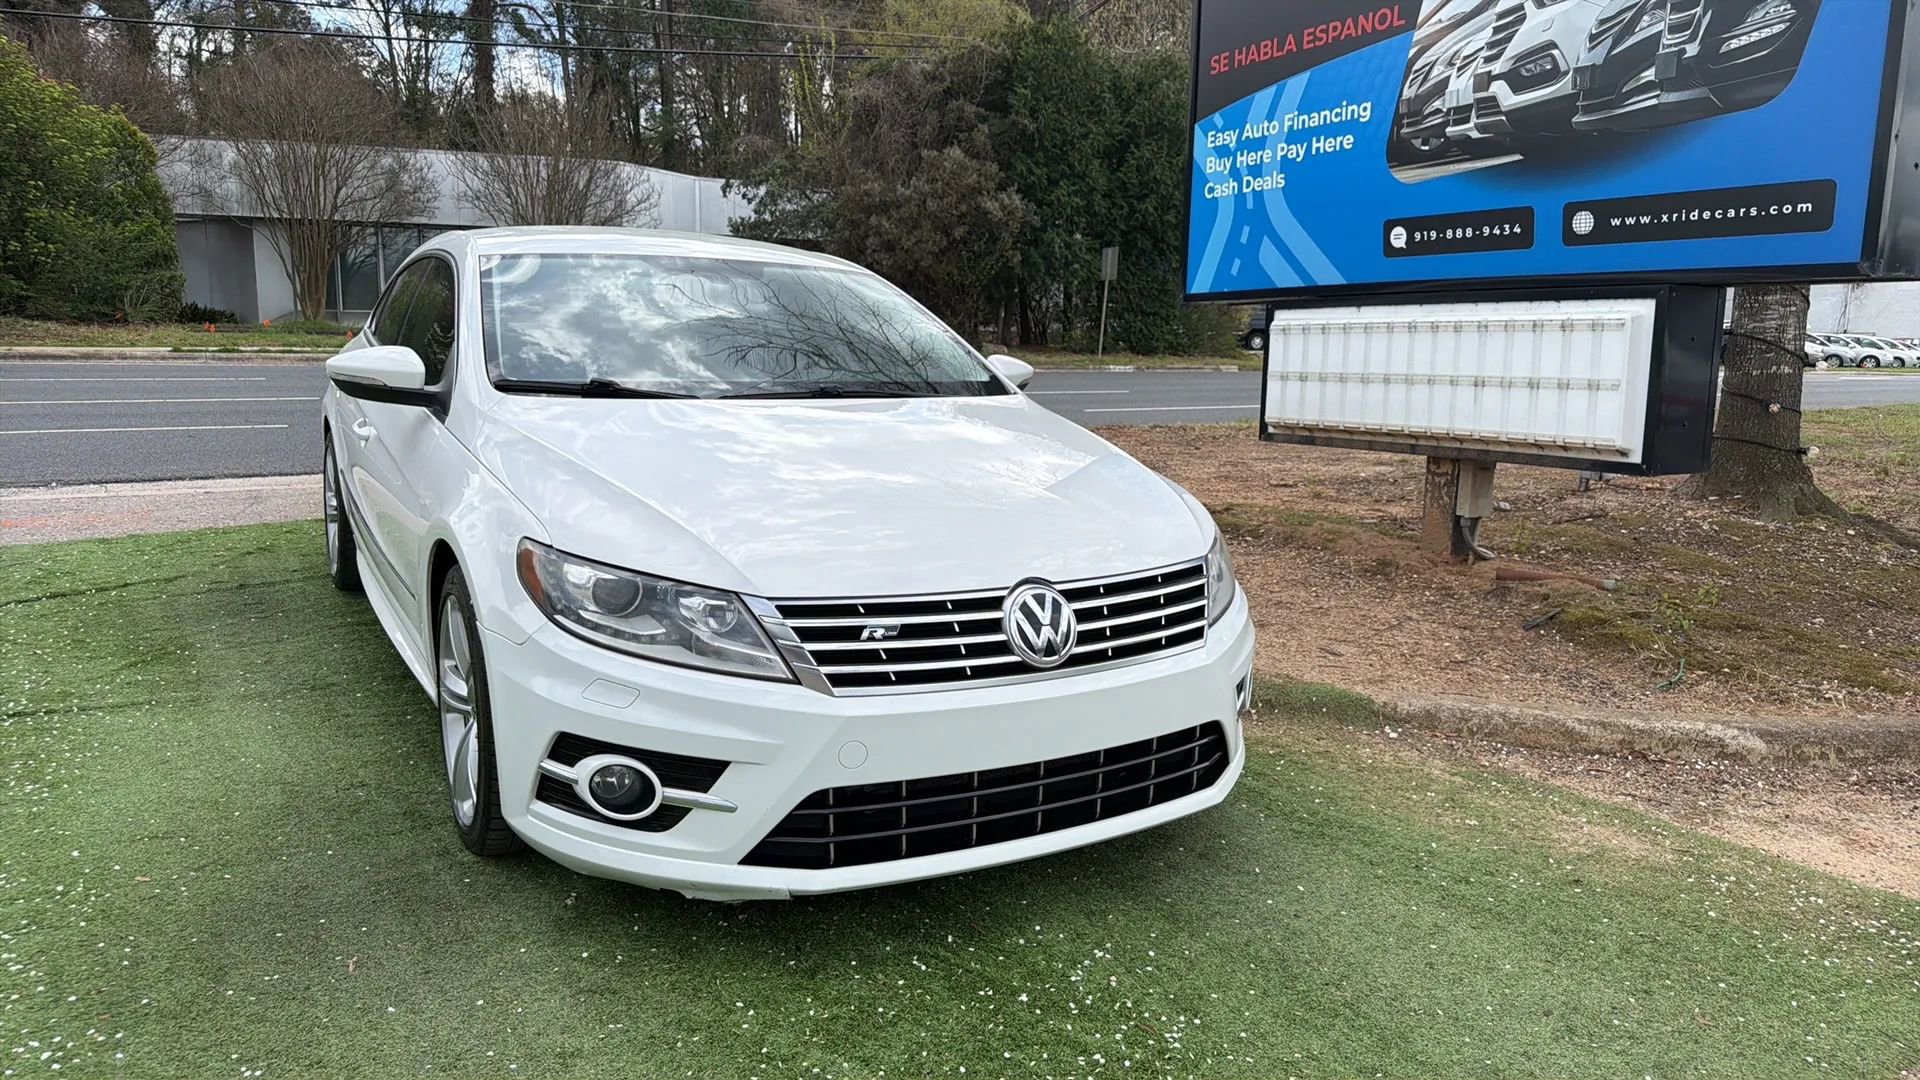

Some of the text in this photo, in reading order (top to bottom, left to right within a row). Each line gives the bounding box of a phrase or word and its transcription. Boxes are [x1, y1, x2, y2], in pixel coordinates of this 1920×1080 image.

[1209, 5, 1405, 75] SE HABLA ESPANOL
[1207, 100, 1372, 149] Easy Auto Financing
[1206, 132, 1354, 176] Buy Here Pay Here
[1204, 171, 1285, 199] Cash Deals
[1414, 223, 1521, 242] 919-888-9434
[1610, 202, 1813, 227] www.xridecars.com
[1008, 586, 1073, 664] VW
